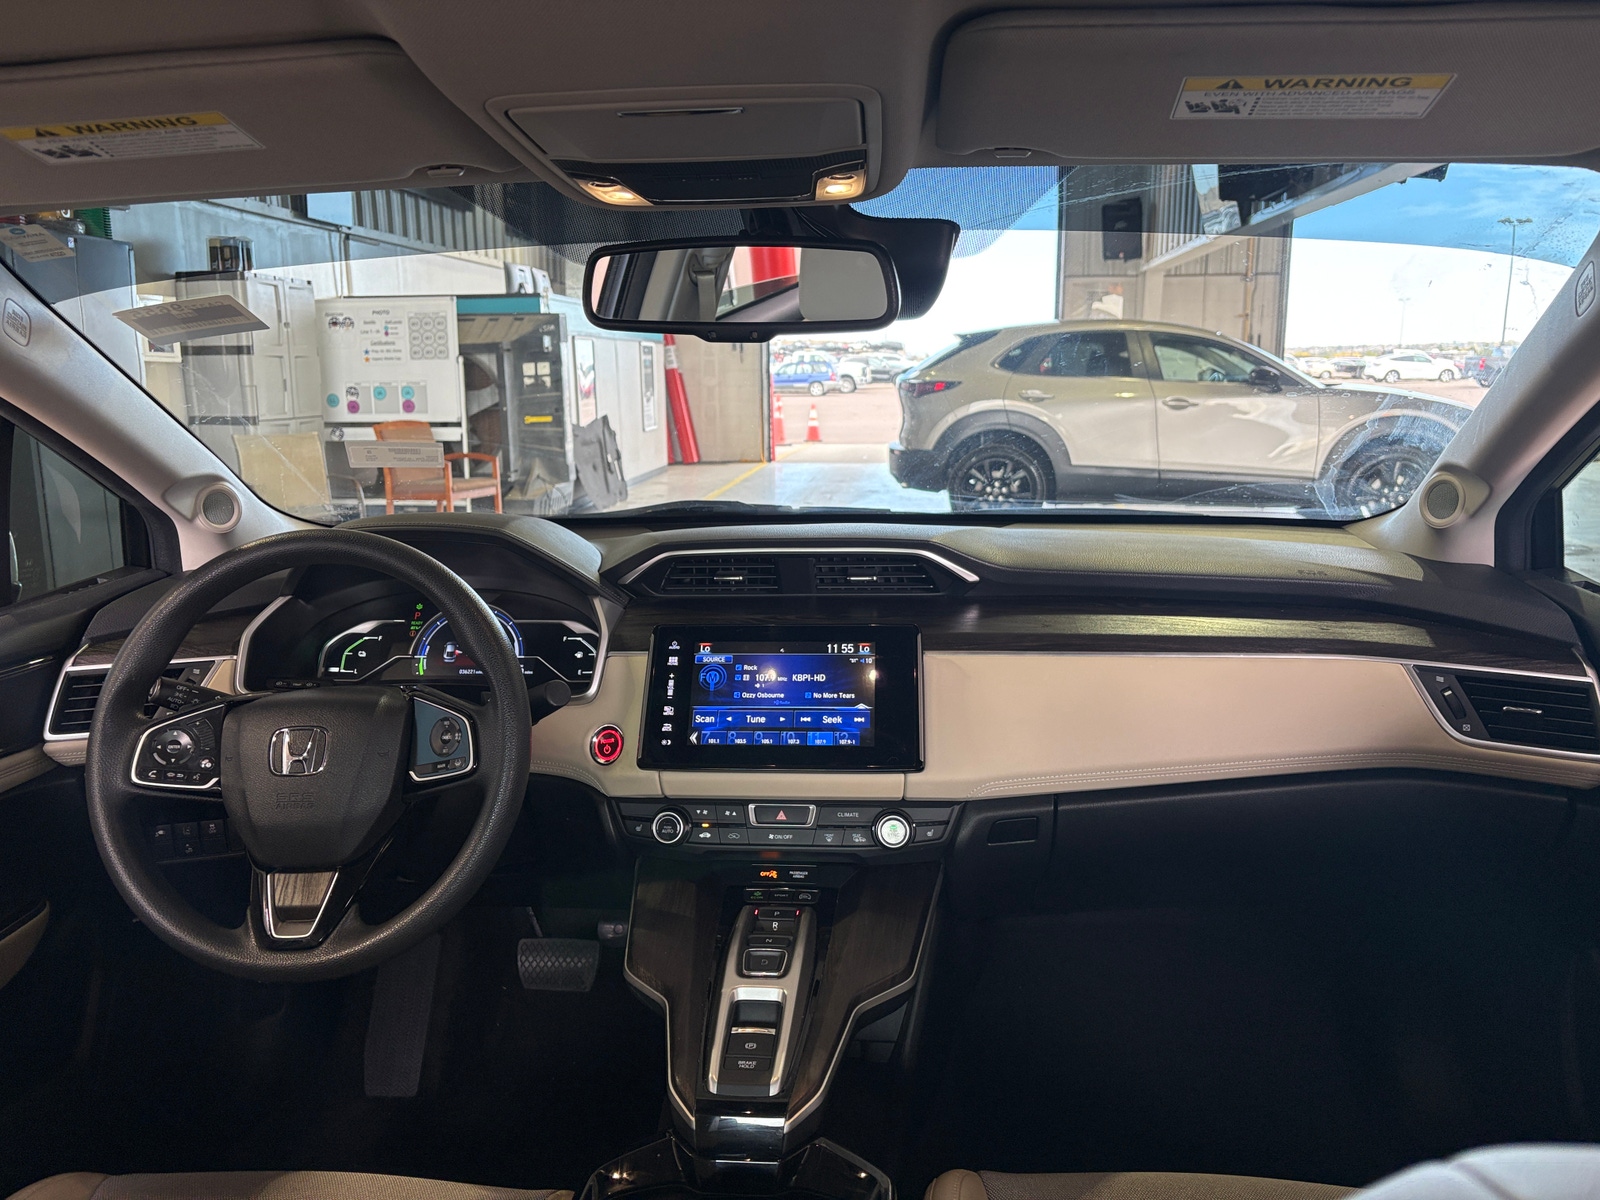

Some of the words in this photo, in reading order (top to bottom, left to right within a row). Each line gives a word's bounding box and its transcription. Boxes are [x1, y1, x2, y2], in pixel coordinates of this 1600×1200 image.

[1263, 77, 1413, 89] WARNING
[65, 115, 199, 135] WARNING
[414, 611, 421, 620] P
[700, 644, 711, 653] Lo
[859, 644, 870, 653] Lo
[792, 673, 826, 682] KBPI-HD
[695, 714, 715, 723] Scan
[745, 715, 766, 723] Tune
[822, 715, 843, 724] Seek
[772, 921, 779, 929] R
